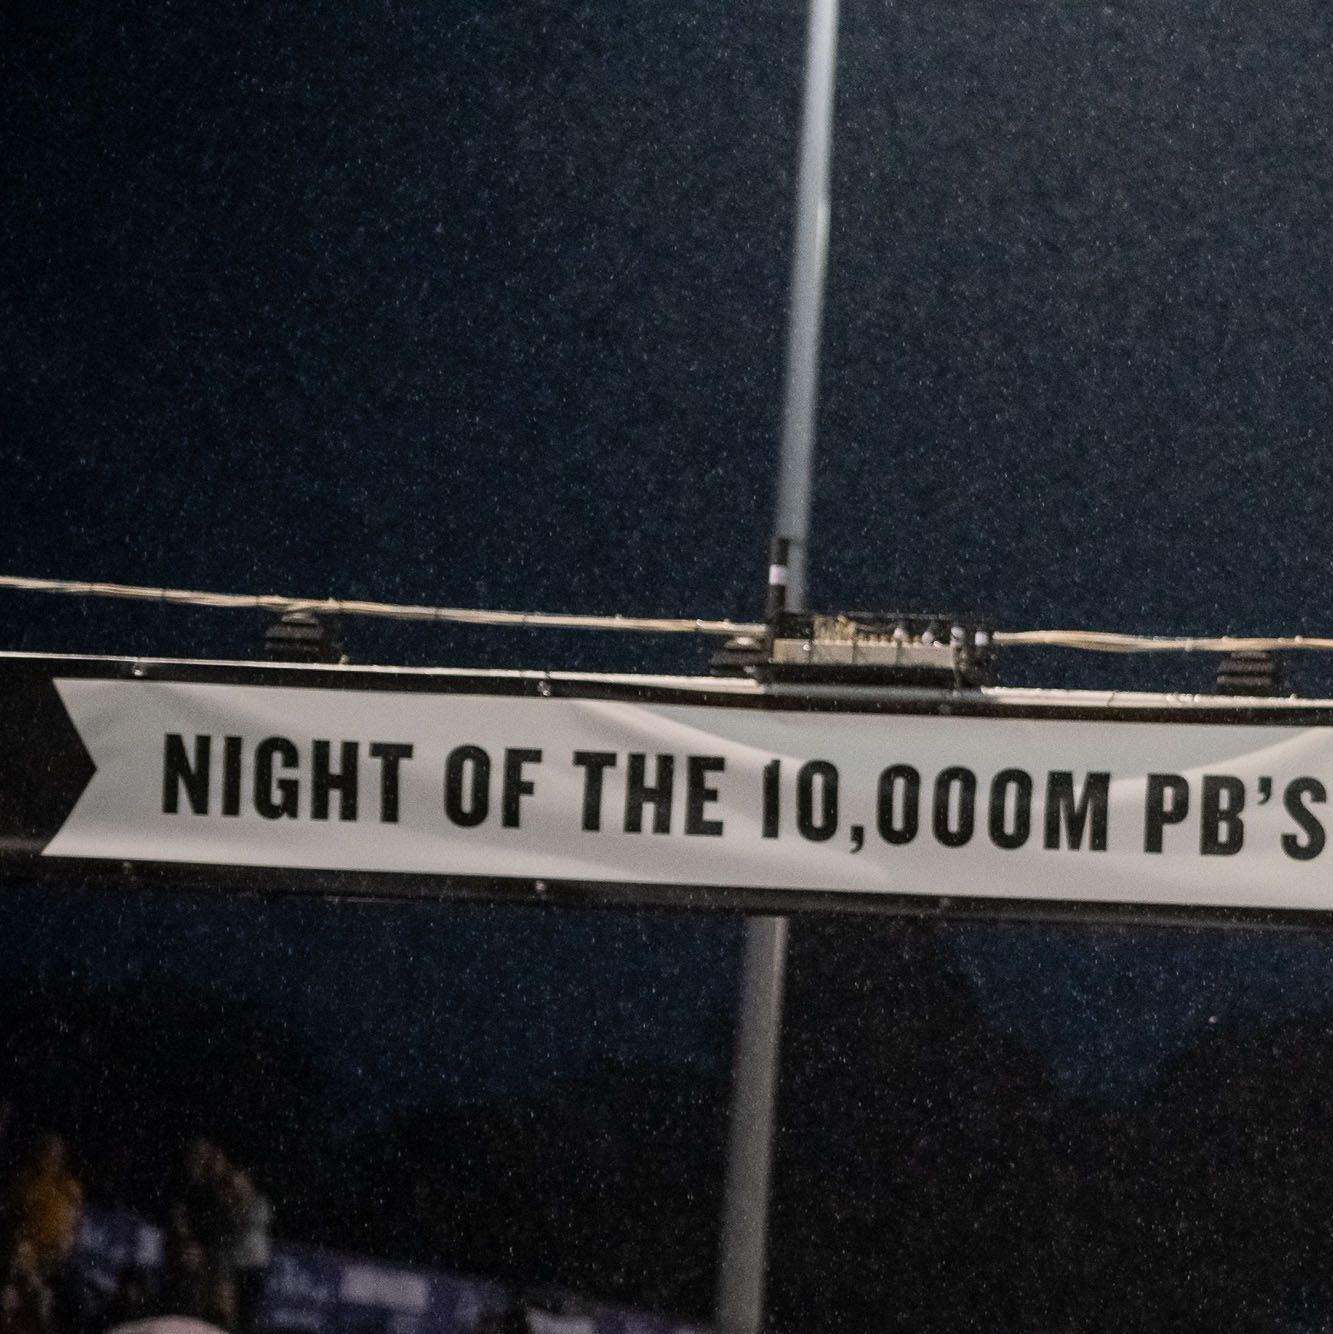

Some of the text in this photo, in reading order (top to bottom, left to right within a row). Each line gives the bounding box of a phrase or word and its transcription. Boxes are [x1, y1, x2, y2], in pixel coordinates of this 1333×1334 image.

[162, 733, 1328, 861] NIGHT OF THE 10,000M PB'S
